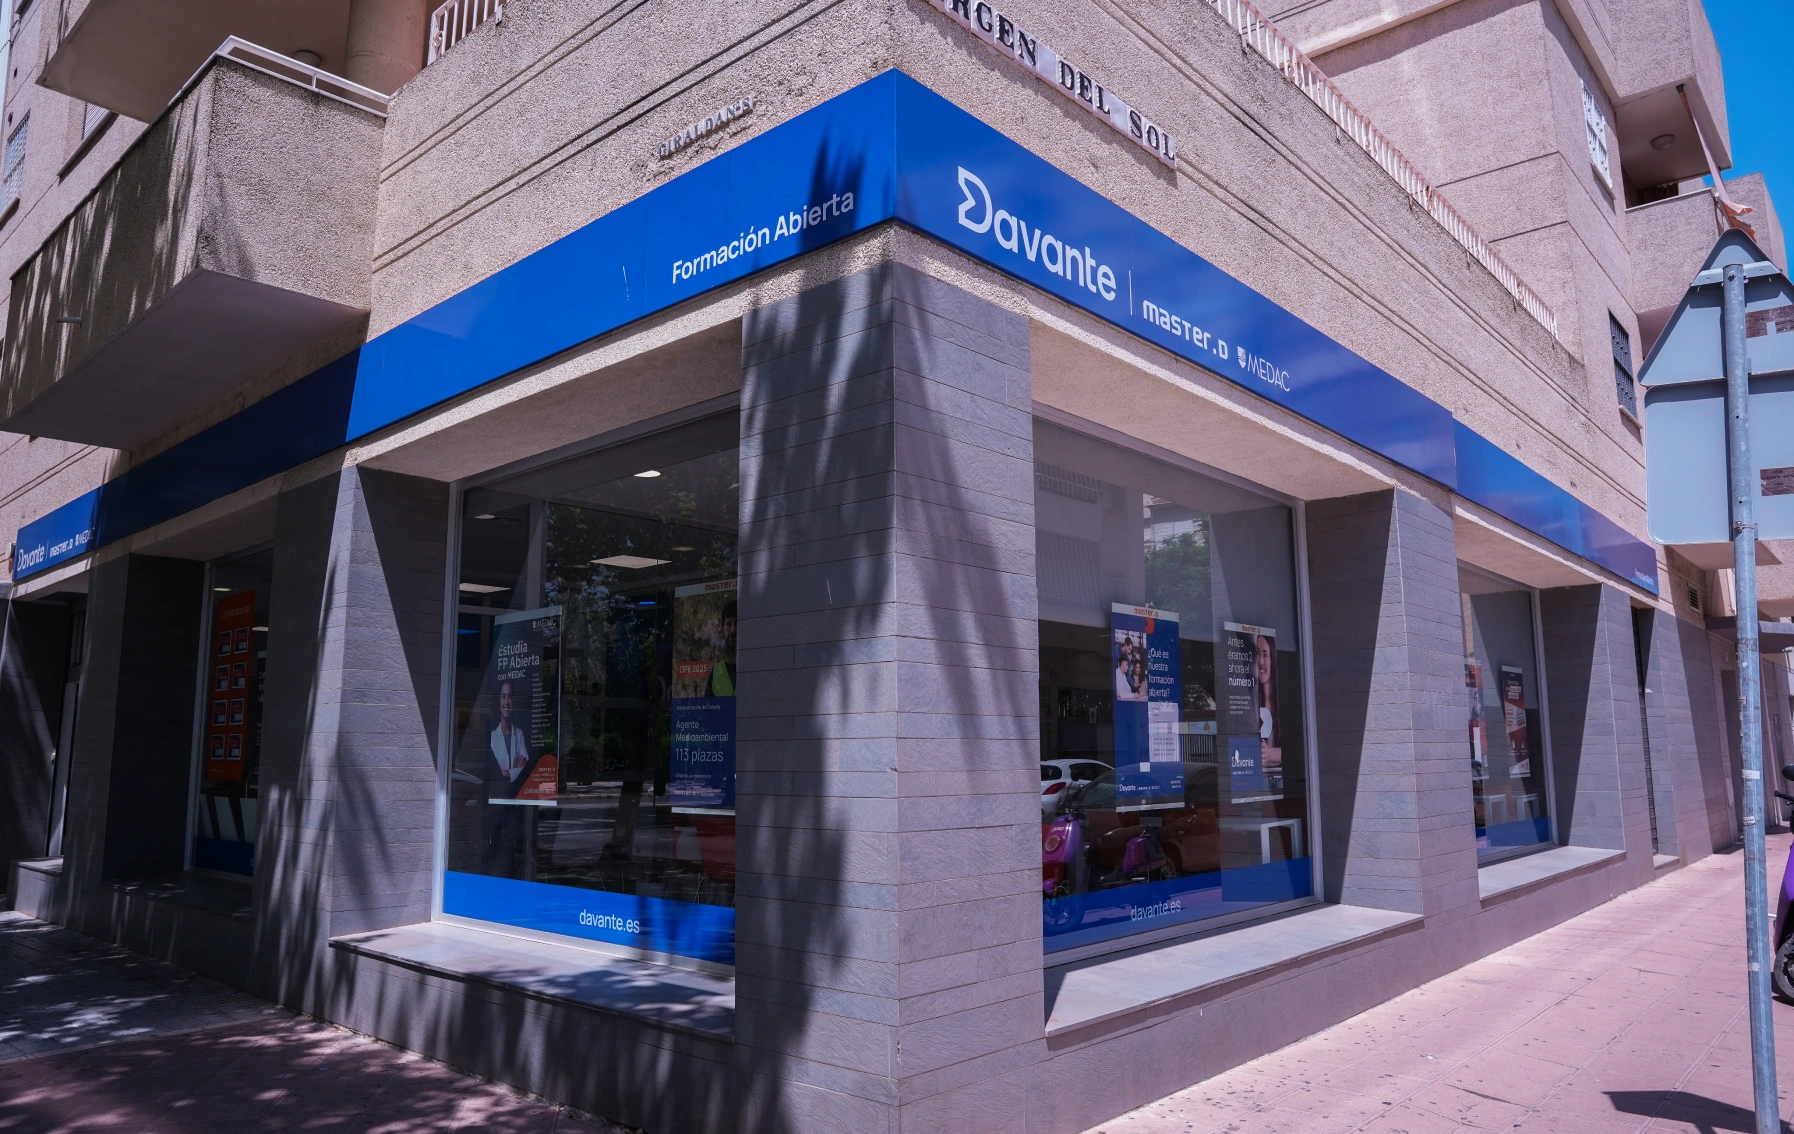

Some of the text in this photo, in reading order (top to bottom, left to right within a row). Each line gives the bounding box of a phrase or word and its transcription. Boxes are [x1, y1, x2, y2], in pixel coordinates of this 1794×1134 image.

[1059, 61, 1111, 116] DEL
[1129, 108, 1175, 161] SOL
[672, 191, 855, 285] Formación Abierta
[957, 165, 1117, 302] Davante
[1248, 352, 1291, 392] MEDAC
[17, 543, 46, 572] Davante
[77, 527, 96, 546] MEDAC
[704, 580, 737, 592] master.
[537, 617, 557, 628] MEDAC
[1227, 636, 1245, 648] Antes
[498, 640, 528, 657] Estudia
[1148, 647, 1170, 659] ¿Qué es
[1228, 649, 1249, 661] éramos
[497, 653, 540, 671] FP Abierta
[1148, 662, 1169, 672] nuestra
[507, 669, 526, 680] MEDAC
[679, 663, 708, 674] OPE 2025
[1228, 663, 1250, 674] ahora el
[1149, 674, 1175, 685] formación
[1228, 675, 1252, 687] número
[1149, 688, 1171, 697] abierta?
[676, 720, 699, 731] Agente
[675, 732, 729, 742] Medioambiental
[675, 748, 724, 766] 113 plazas
[1131, 900, 1182, 921] davante.es
[579, 909, 641, 934] davante.es
